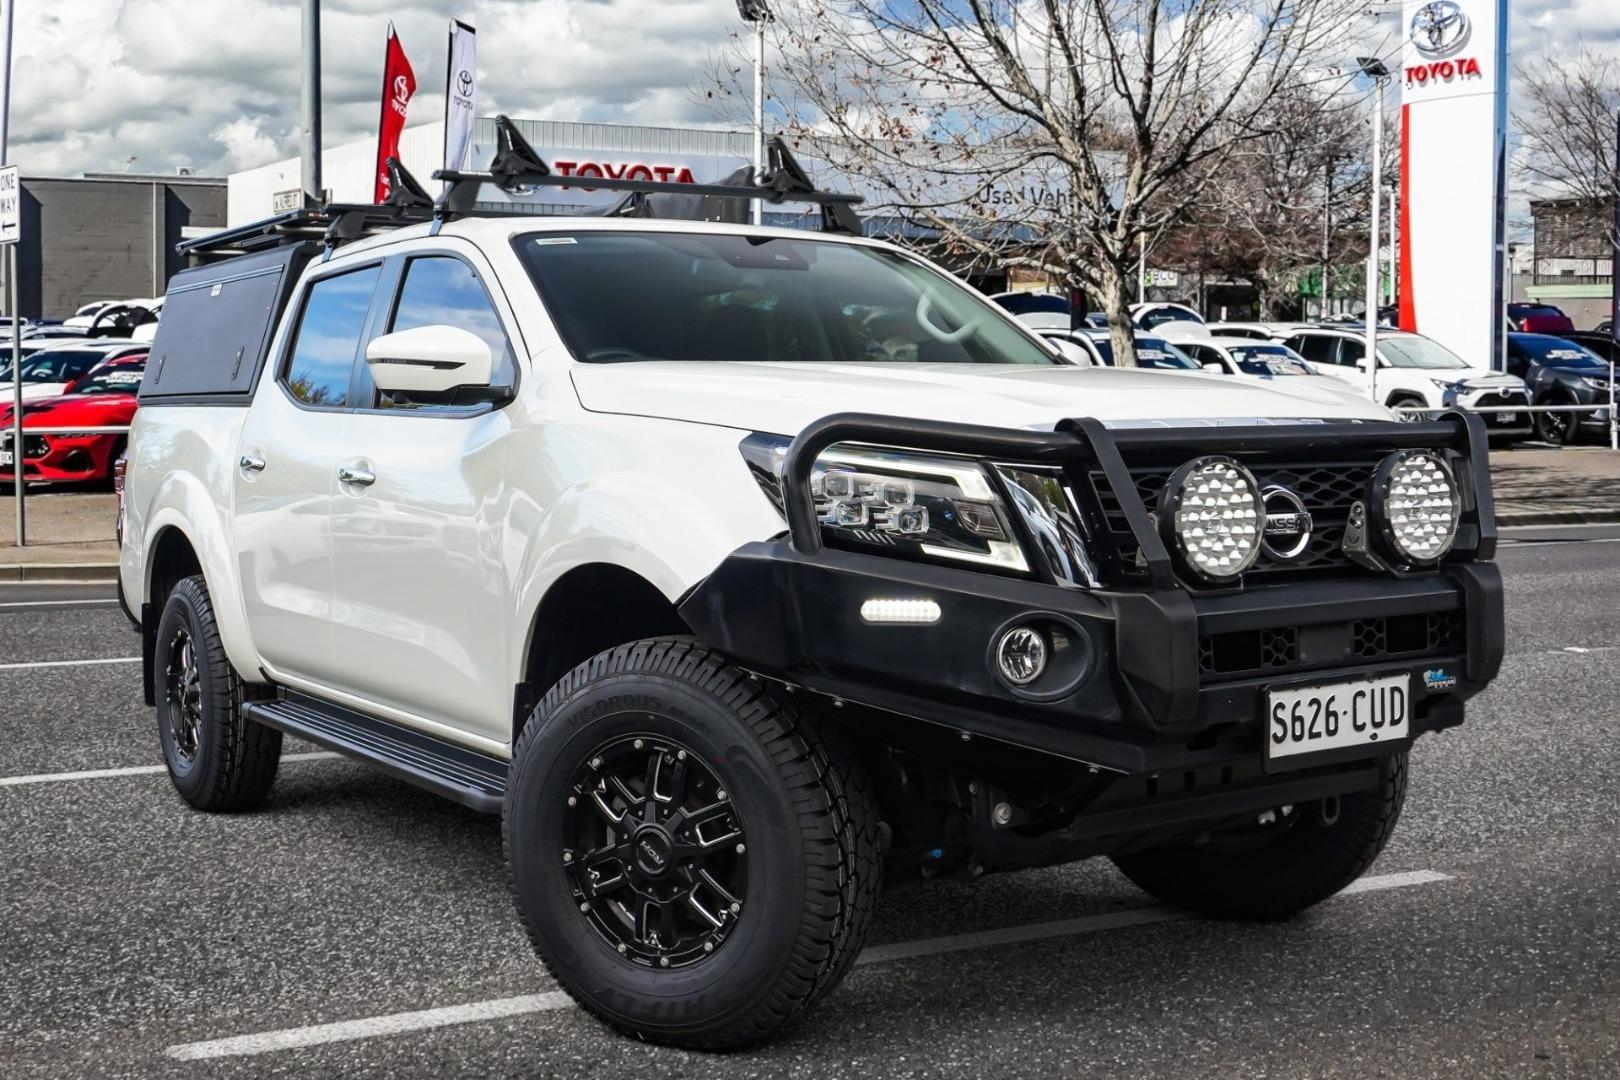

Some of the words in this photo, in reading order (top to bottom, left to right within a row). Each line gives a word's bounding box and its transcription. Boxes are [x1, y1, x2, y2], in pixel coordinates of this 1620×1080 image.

[1404, 58, 1480, 83] TOYOTA
[1, 173, 15, 191] ONE
[555, 161, 695, 192] TOYOTA
[1, 196, 16, 213] WAY
[567, 694, 661, 727] VIGOROUS
